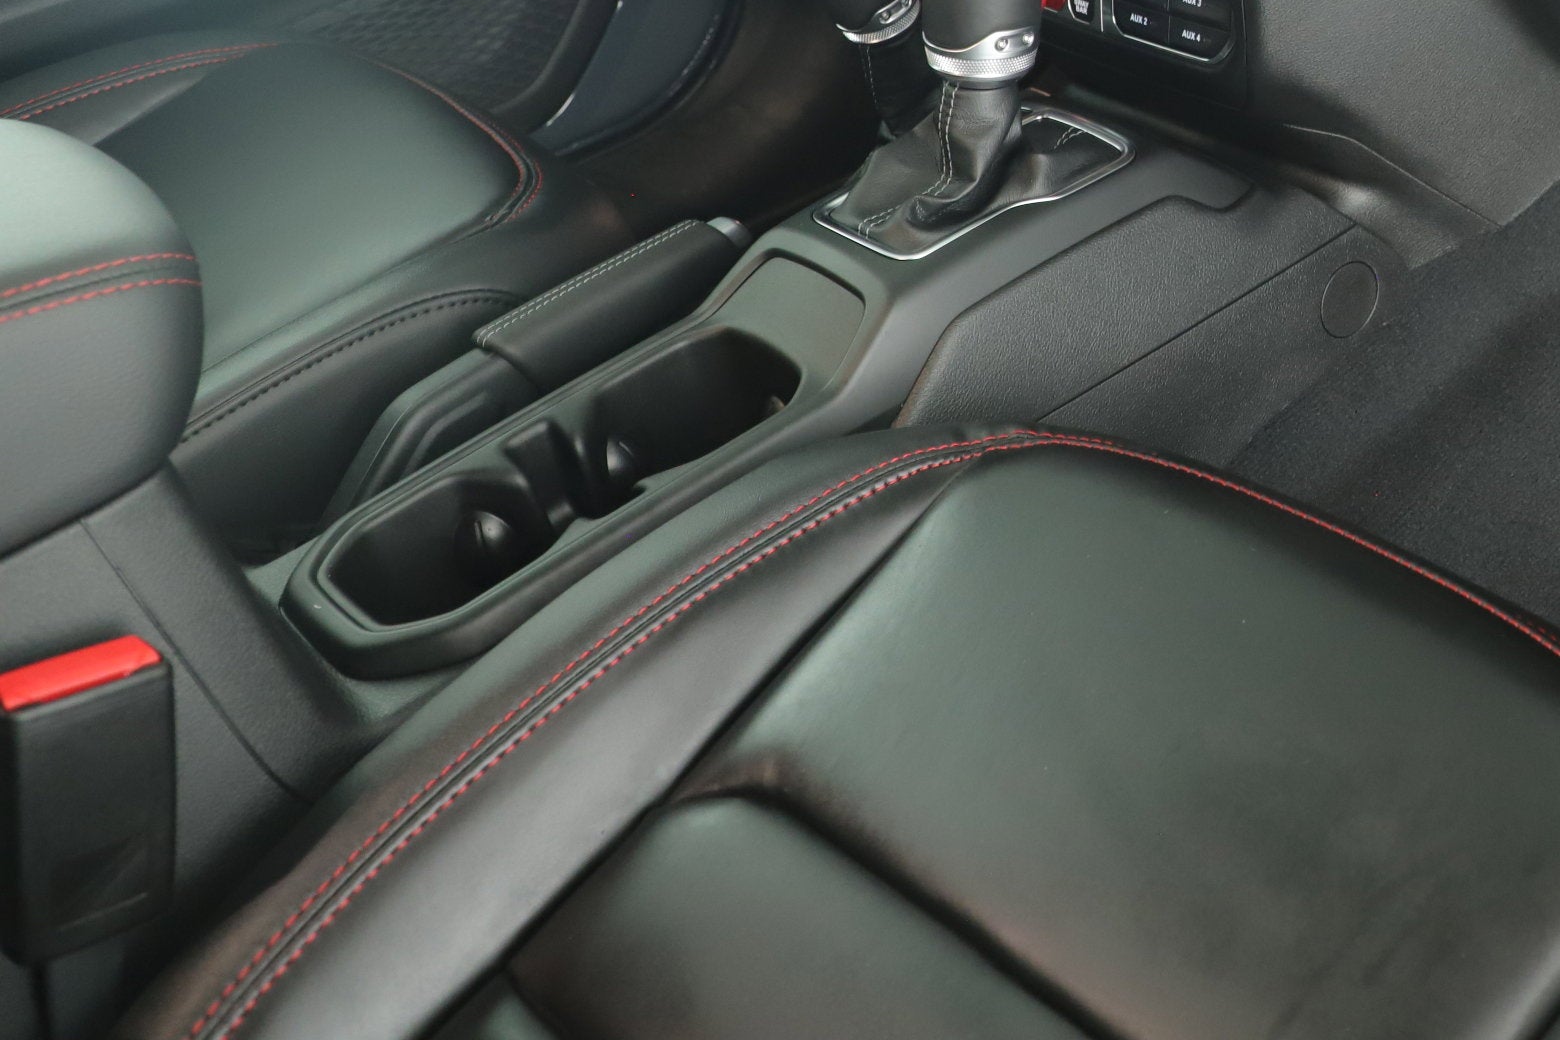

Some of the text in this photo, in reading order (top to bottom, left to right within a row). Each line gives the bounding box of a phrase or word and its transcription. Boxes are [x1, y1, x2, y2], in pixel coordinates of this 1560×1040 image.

[1074, 5, 1088, 16] BAR
[1129, 12, 1149, 26] AUX 2
[1181, 28, 1201, 43] AUX 4
